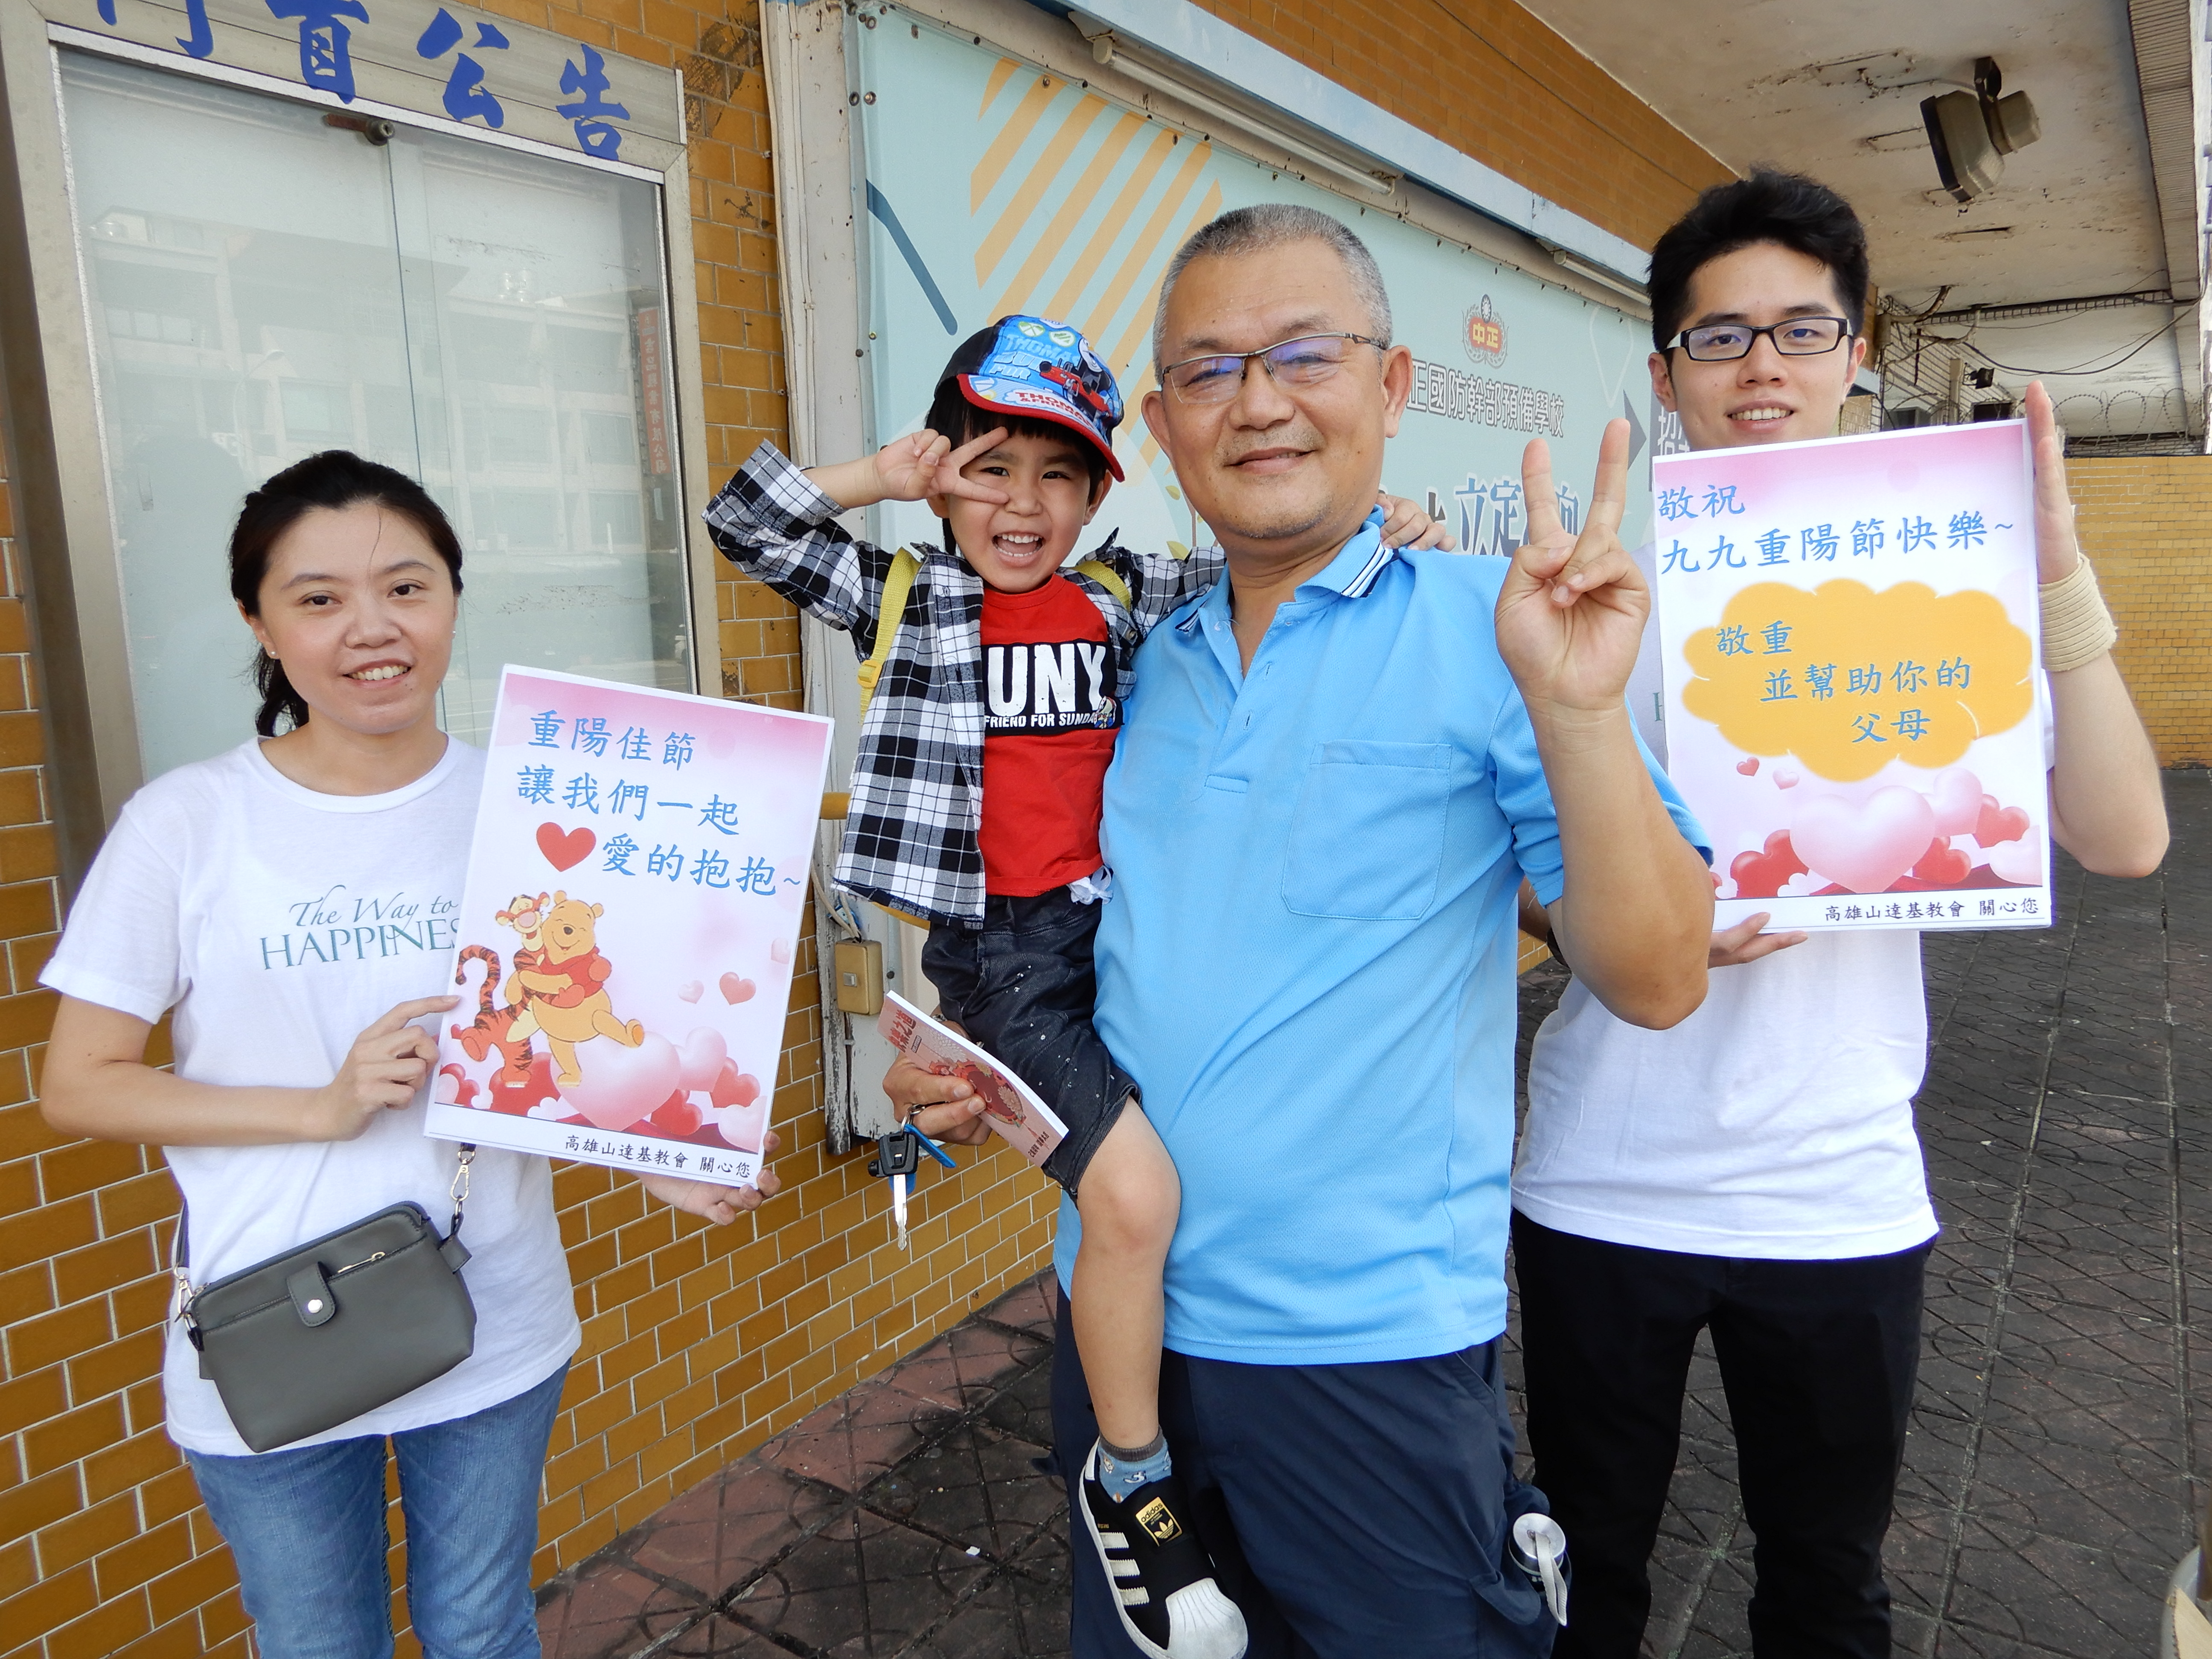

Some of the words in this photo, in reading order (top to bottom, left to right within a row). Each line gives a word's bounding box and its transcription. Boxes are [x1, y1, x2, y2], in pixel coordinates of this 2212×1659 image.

[97, 0, 631, 161] 首公告
[1473, 323, 1498, 348] 中正
[989, 364, 1031, 381] FOR
[1406, 358, 1563, 438] 正國防幹部預備學校
[1657, 485, 1745, 521] 敬祝
[1716, 620, 1793, 656] 敬重
[1759, 656, 1971, 703] 並幫助你的
[985, 715, 1026, 728] FRIEND
[1031, 713, 1055, 727] FOR
[1851, 709, 1931, 743] 父母
[528, 709, 696, 771] 重陽佳節
[517, 764, 739, 835] 讓我們一起
[289, 885, 346, 926] The
[354, 892, 419, 939] Way
[431, 895, 459, 914] to
[1825, 900, 1965, 921] 高雄山達基教會
[1979, 897, 2039, 916] 關心您
[565, 1135, 689, 1169] 高雄山達基教會
[699, 1156, 751, 1179] 關心您
[1141, 1503, 1163, 1522] adidas
